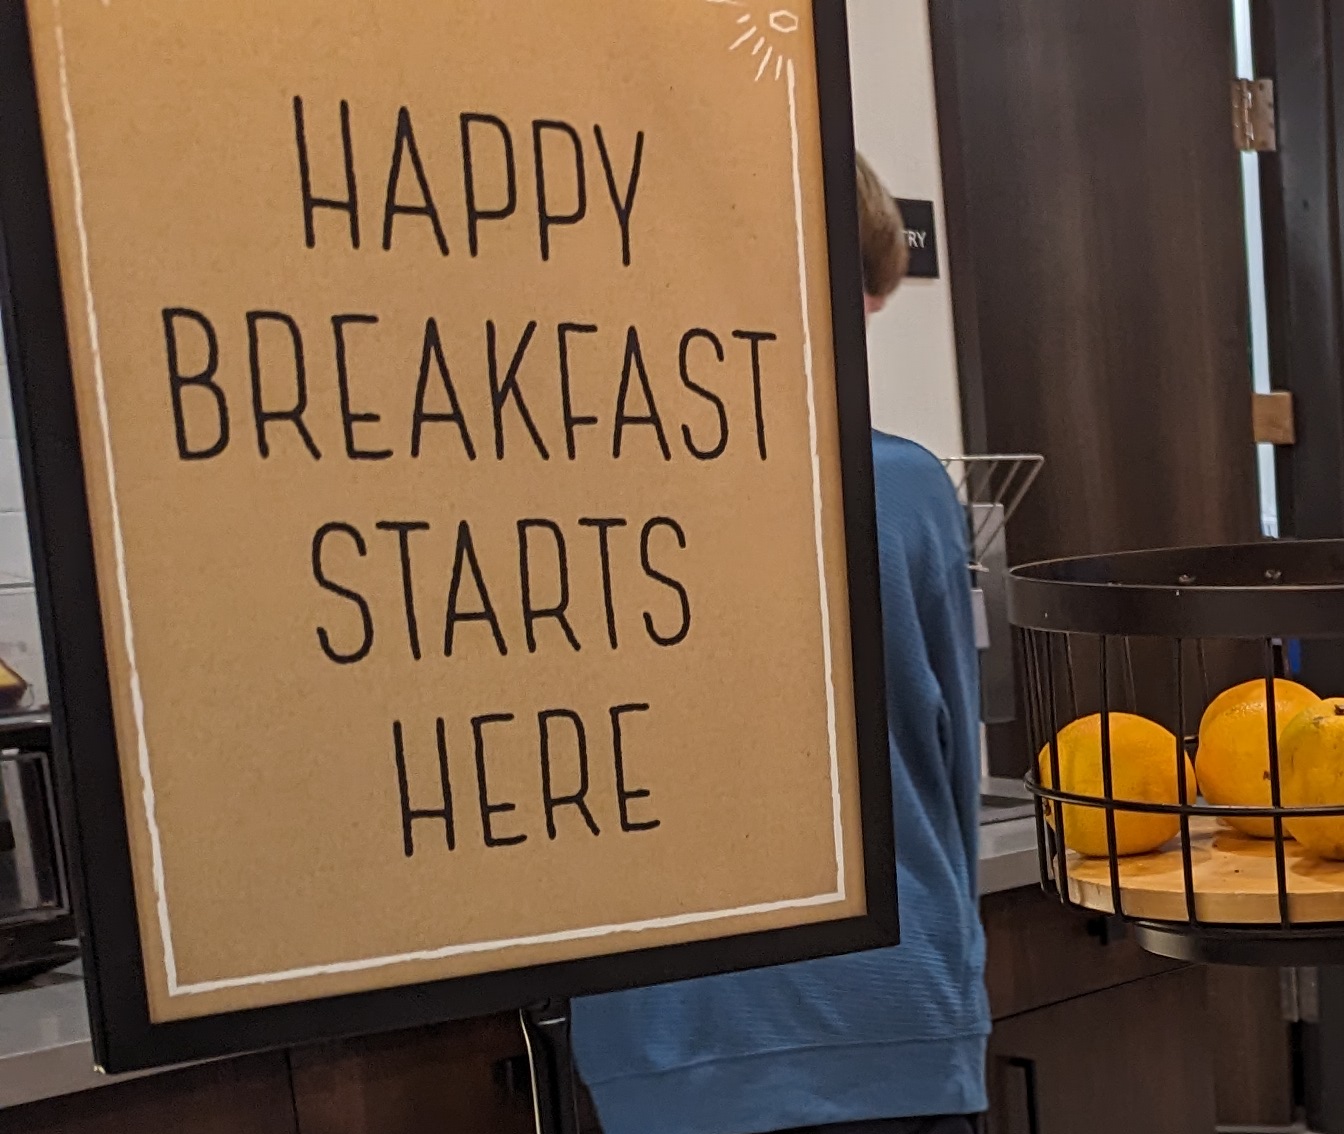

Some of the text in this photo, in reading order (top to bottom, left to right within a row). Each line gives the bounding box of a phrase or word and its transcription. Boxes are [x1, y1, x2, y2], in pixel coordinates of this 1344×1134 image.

[293, 96, 644, 266] HAPPY
[903, 230, 927, 249] RY
[161, 308, 777, 462] BREAKFAST
[311, 517, 691, 664] STARTS
[393, 703, 661, 857] HERE
